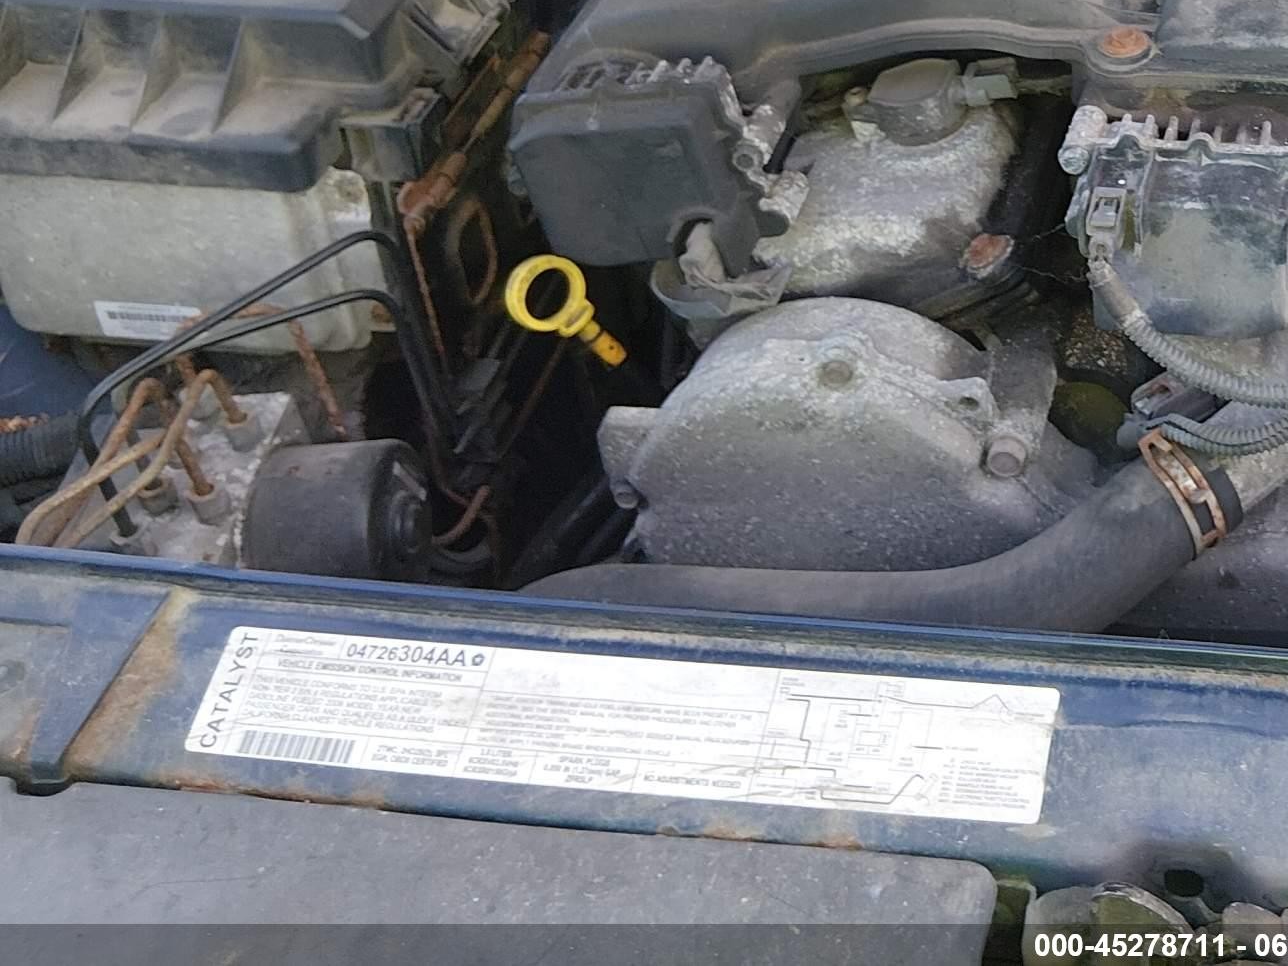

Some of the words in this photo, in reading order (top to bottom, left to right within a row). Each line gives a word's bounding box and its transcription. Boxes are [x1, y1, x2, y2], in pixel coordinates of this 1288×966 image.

[346, 643, 466, 666] 04726304AA
[278, 658, 313, 669] VEHICLE
[358, 665, 398, 677] CONTROL
[401, 669, 462, 682] INFORMATION
[200, 633, 258, 747] CATALYST
